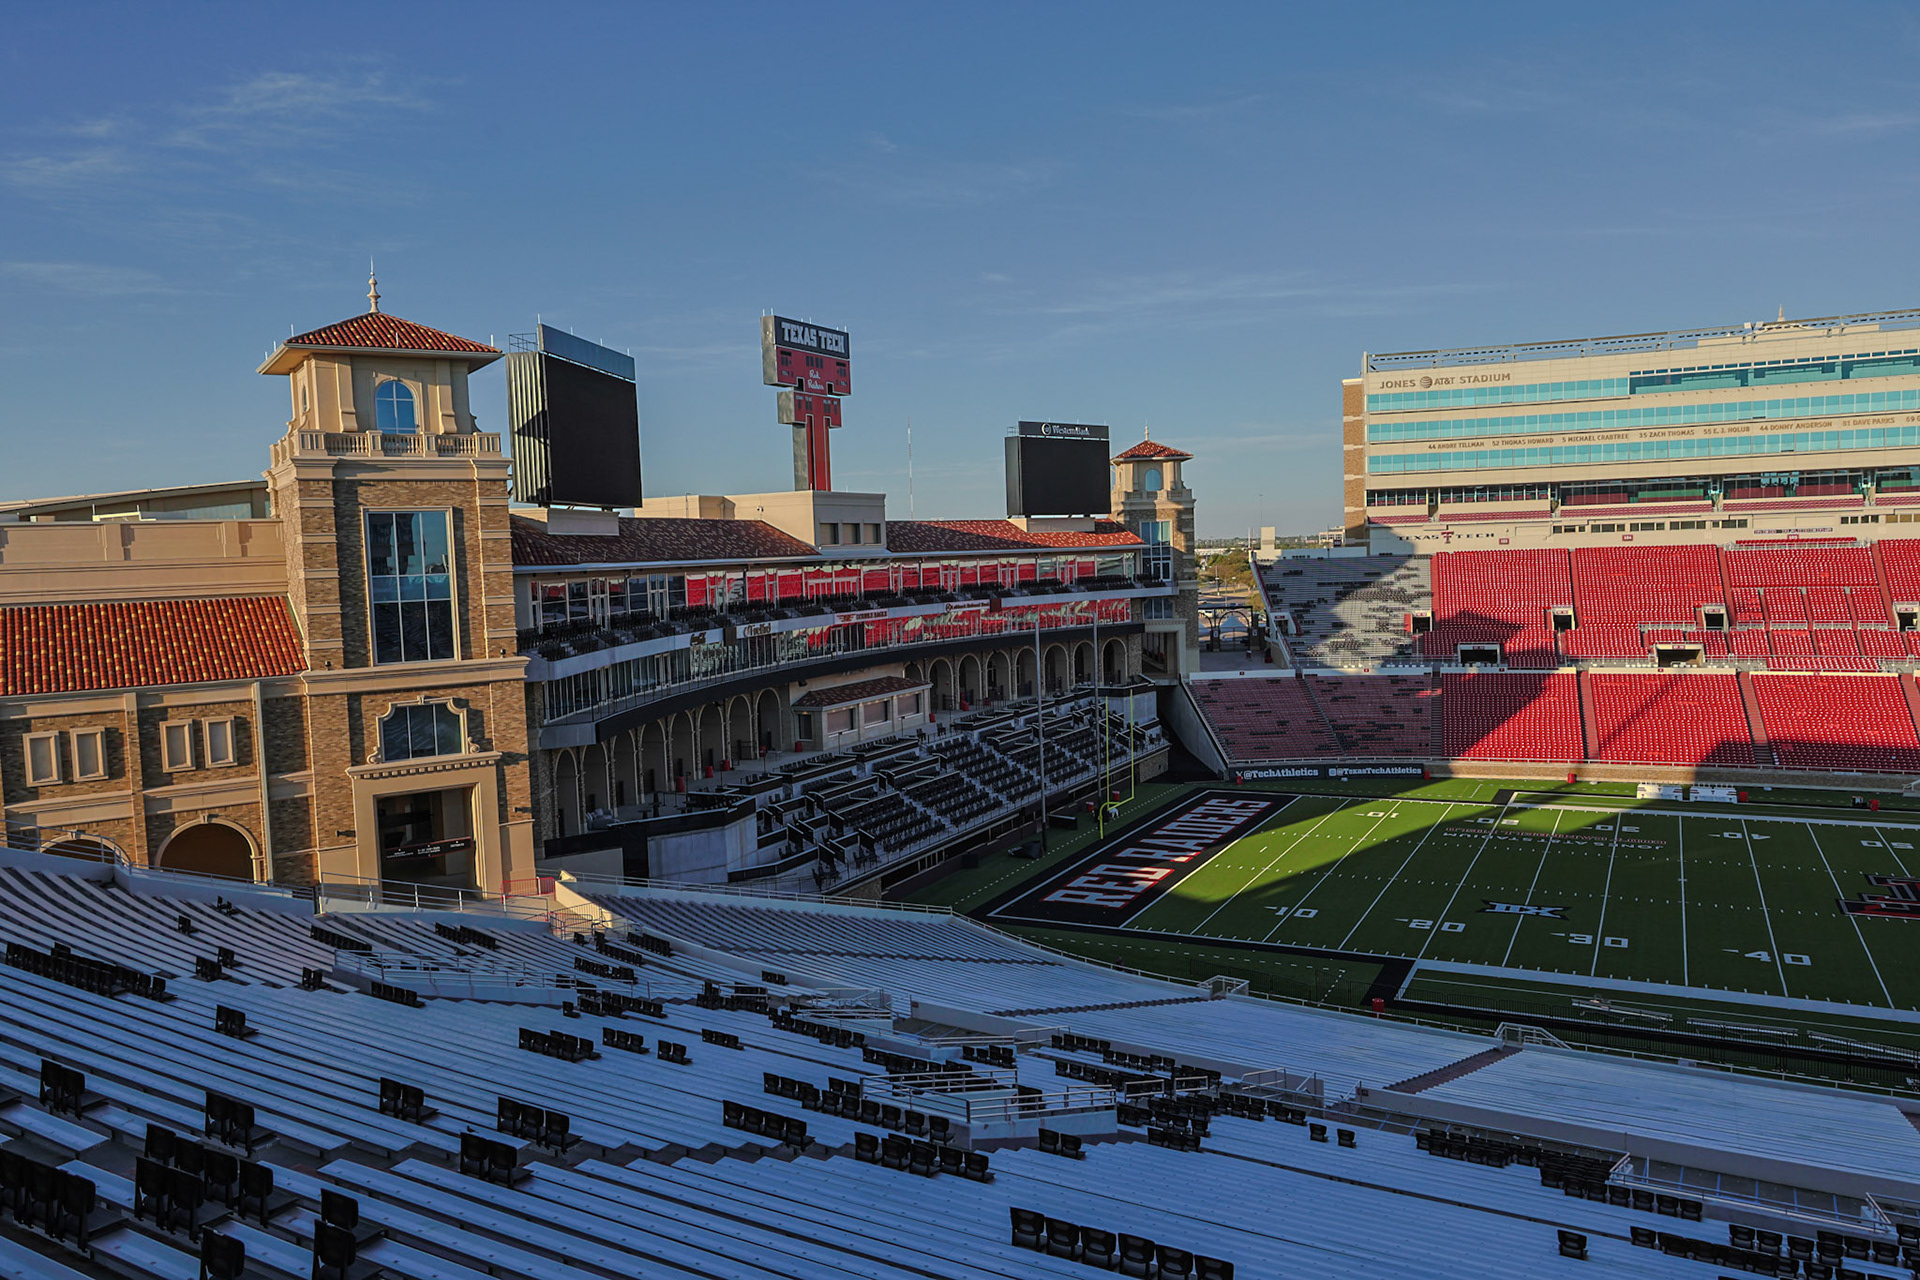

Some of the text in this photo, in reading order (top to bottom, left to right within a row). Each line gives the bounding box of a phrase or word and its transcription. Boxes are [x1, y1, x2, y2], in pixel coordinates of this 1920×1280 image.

[781, 321, 845, 354] TEXAS TECH
[1379, 373, 1511, 389] JONES AT&T STADIUM
[1527, 437, 1555, 445] HOWARD
[1567, 435, 1596, 443] MICHAEL
[1597, 433, 1629, 441] CRABTREE
[1667, 429, 1695, 437] THOMAS
[1769, 423, 1794, 431] DONNY
[1795, 421, 1833, 430] ANDERSON
[1852, 419, 1871, 427] DAVE
[1872, 417, 1896, 425] PARKS
[1244, 767, 1319, 780] @TechAthletics
[1337, 767, 1422, 776] @TexasTechAthletics
[1040, 798, 1274, 909] RED RAIDERS
[1275, 906, 1318, 919] 10
[1408, 918, 1466, 933] 20
[1568, 933, 1629, 948] 30
[1744, 951, 1812, 966] 40
